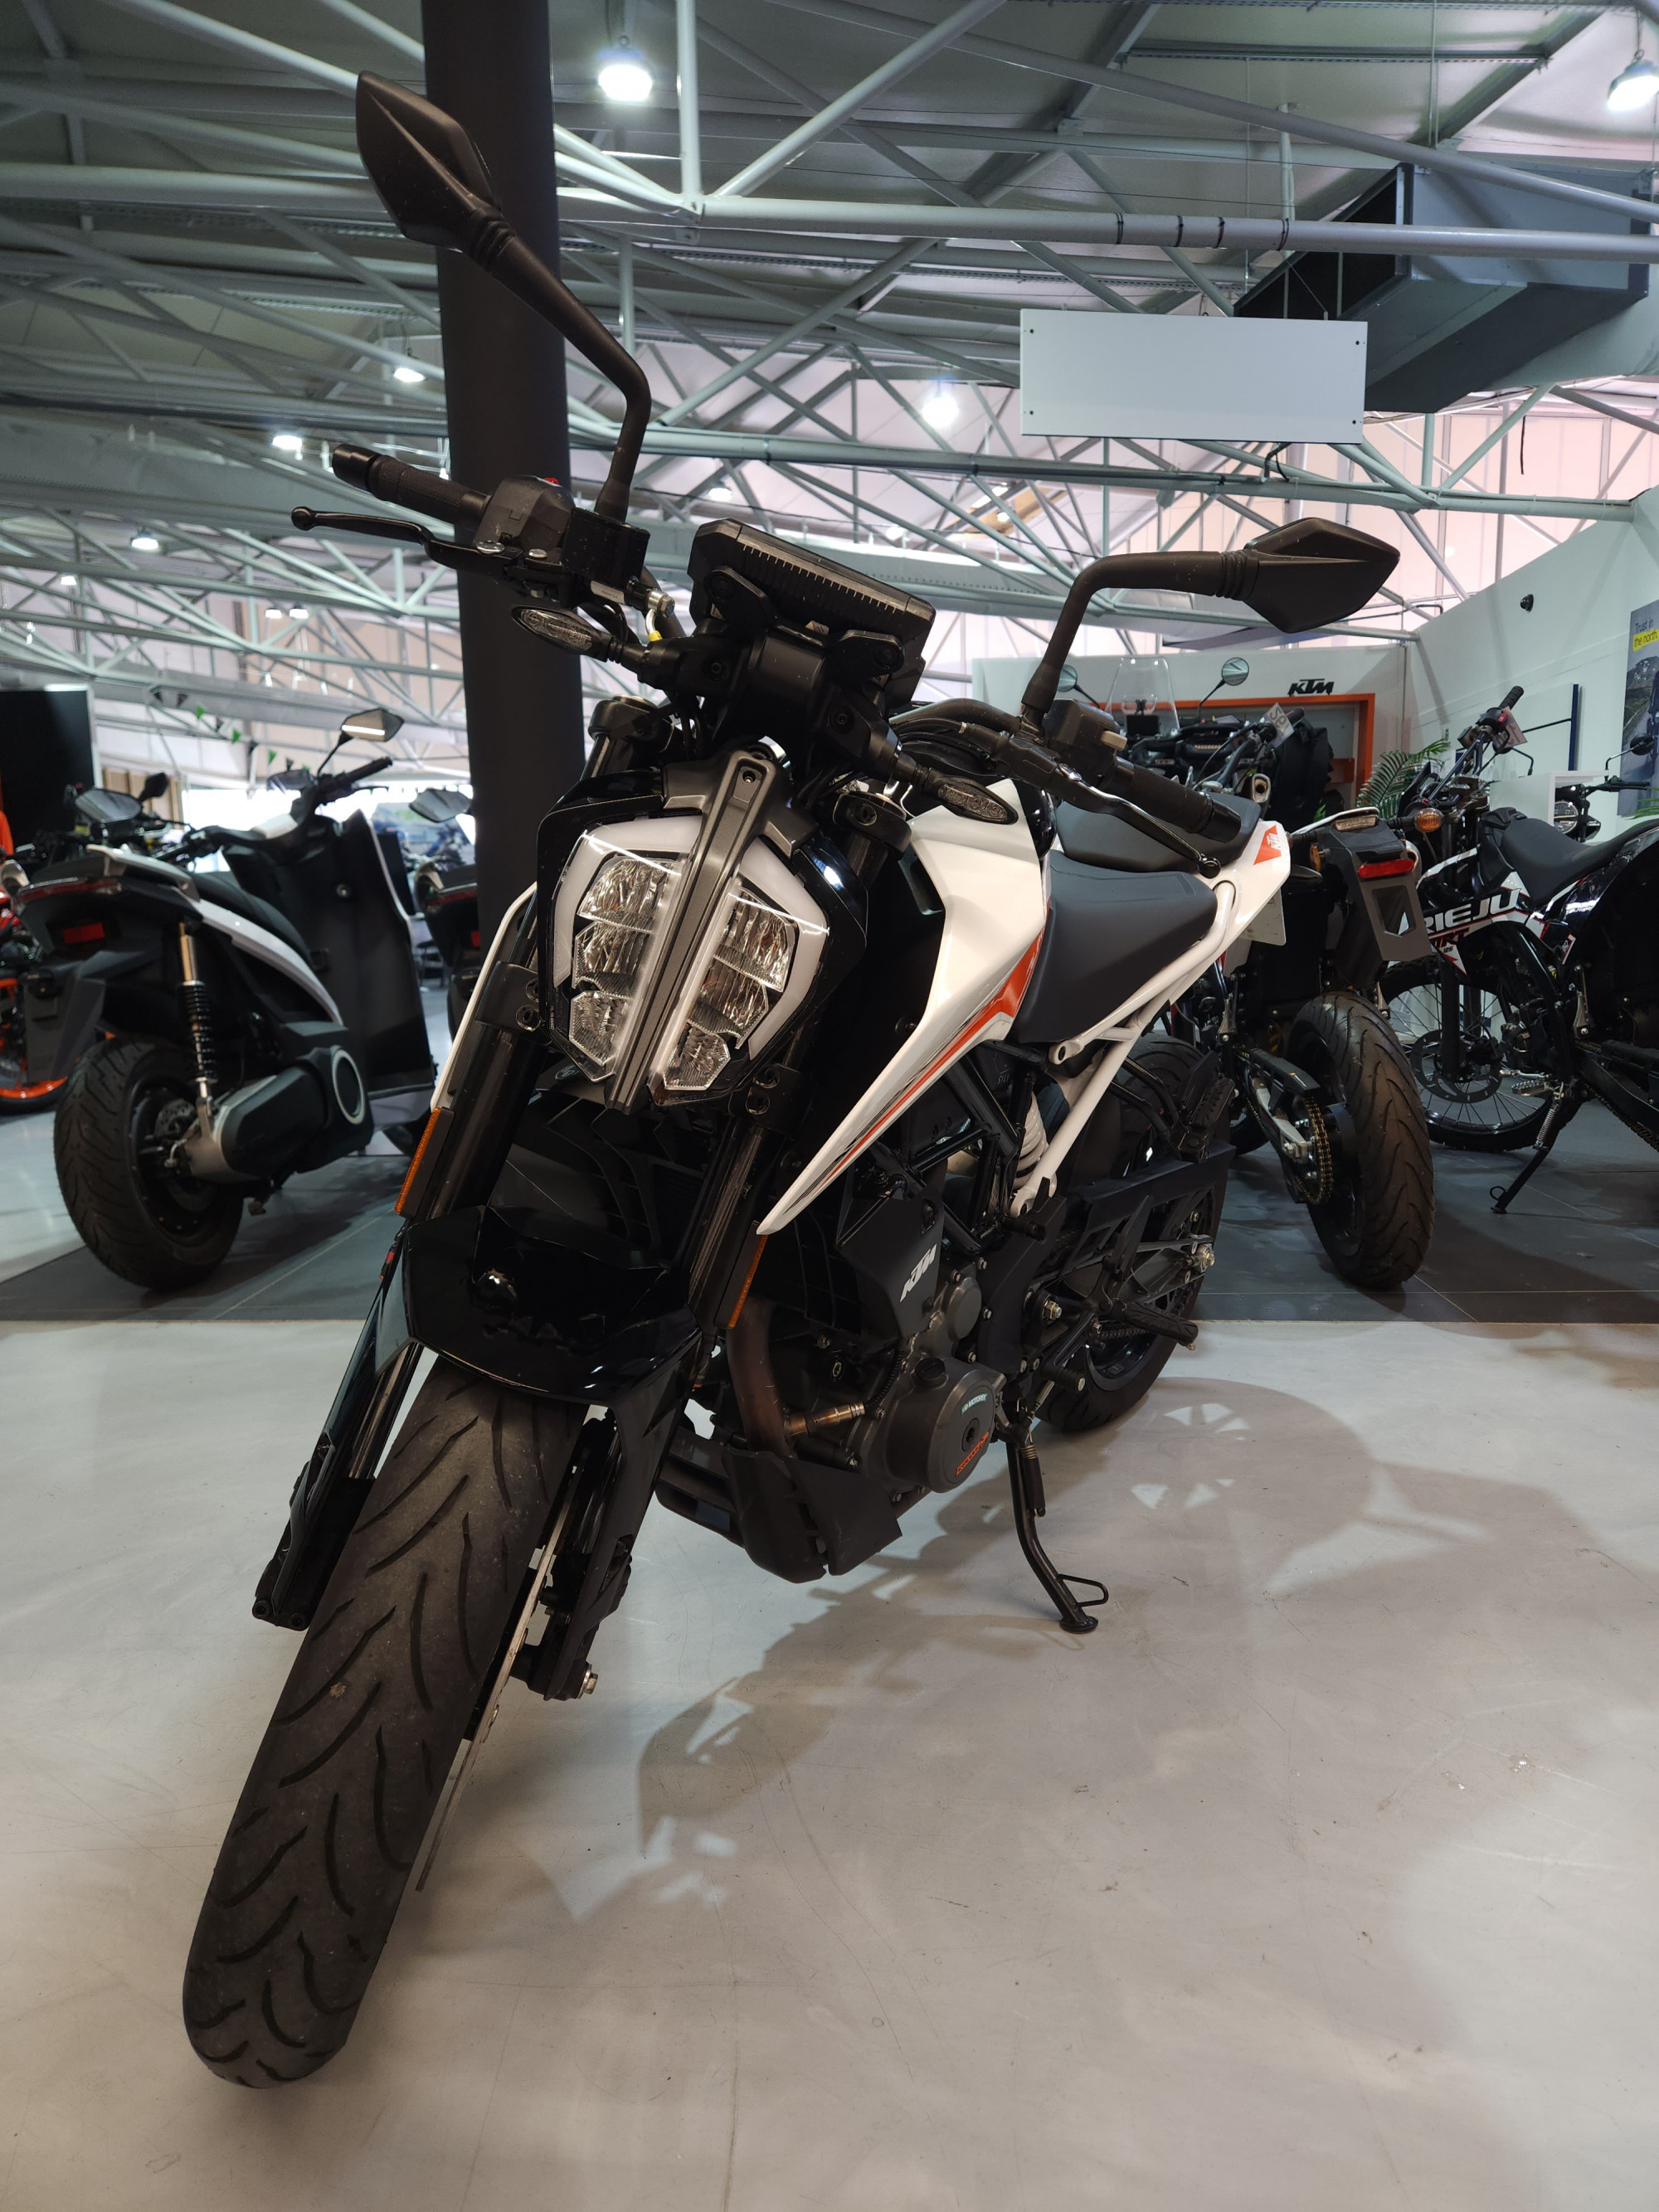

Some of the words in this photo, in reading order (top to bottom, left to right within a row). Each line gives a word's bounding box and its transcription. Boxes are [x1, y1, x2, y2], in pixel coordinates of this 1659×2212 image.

[1634, 636, 1643, 648] the
[1287, 678, 1334, 696] KTM
[1267, 832, 1282, 851] KTM
[1423, 888, 1521, 934] RIEJU
[900, 1243, 937, 1302] KTM
